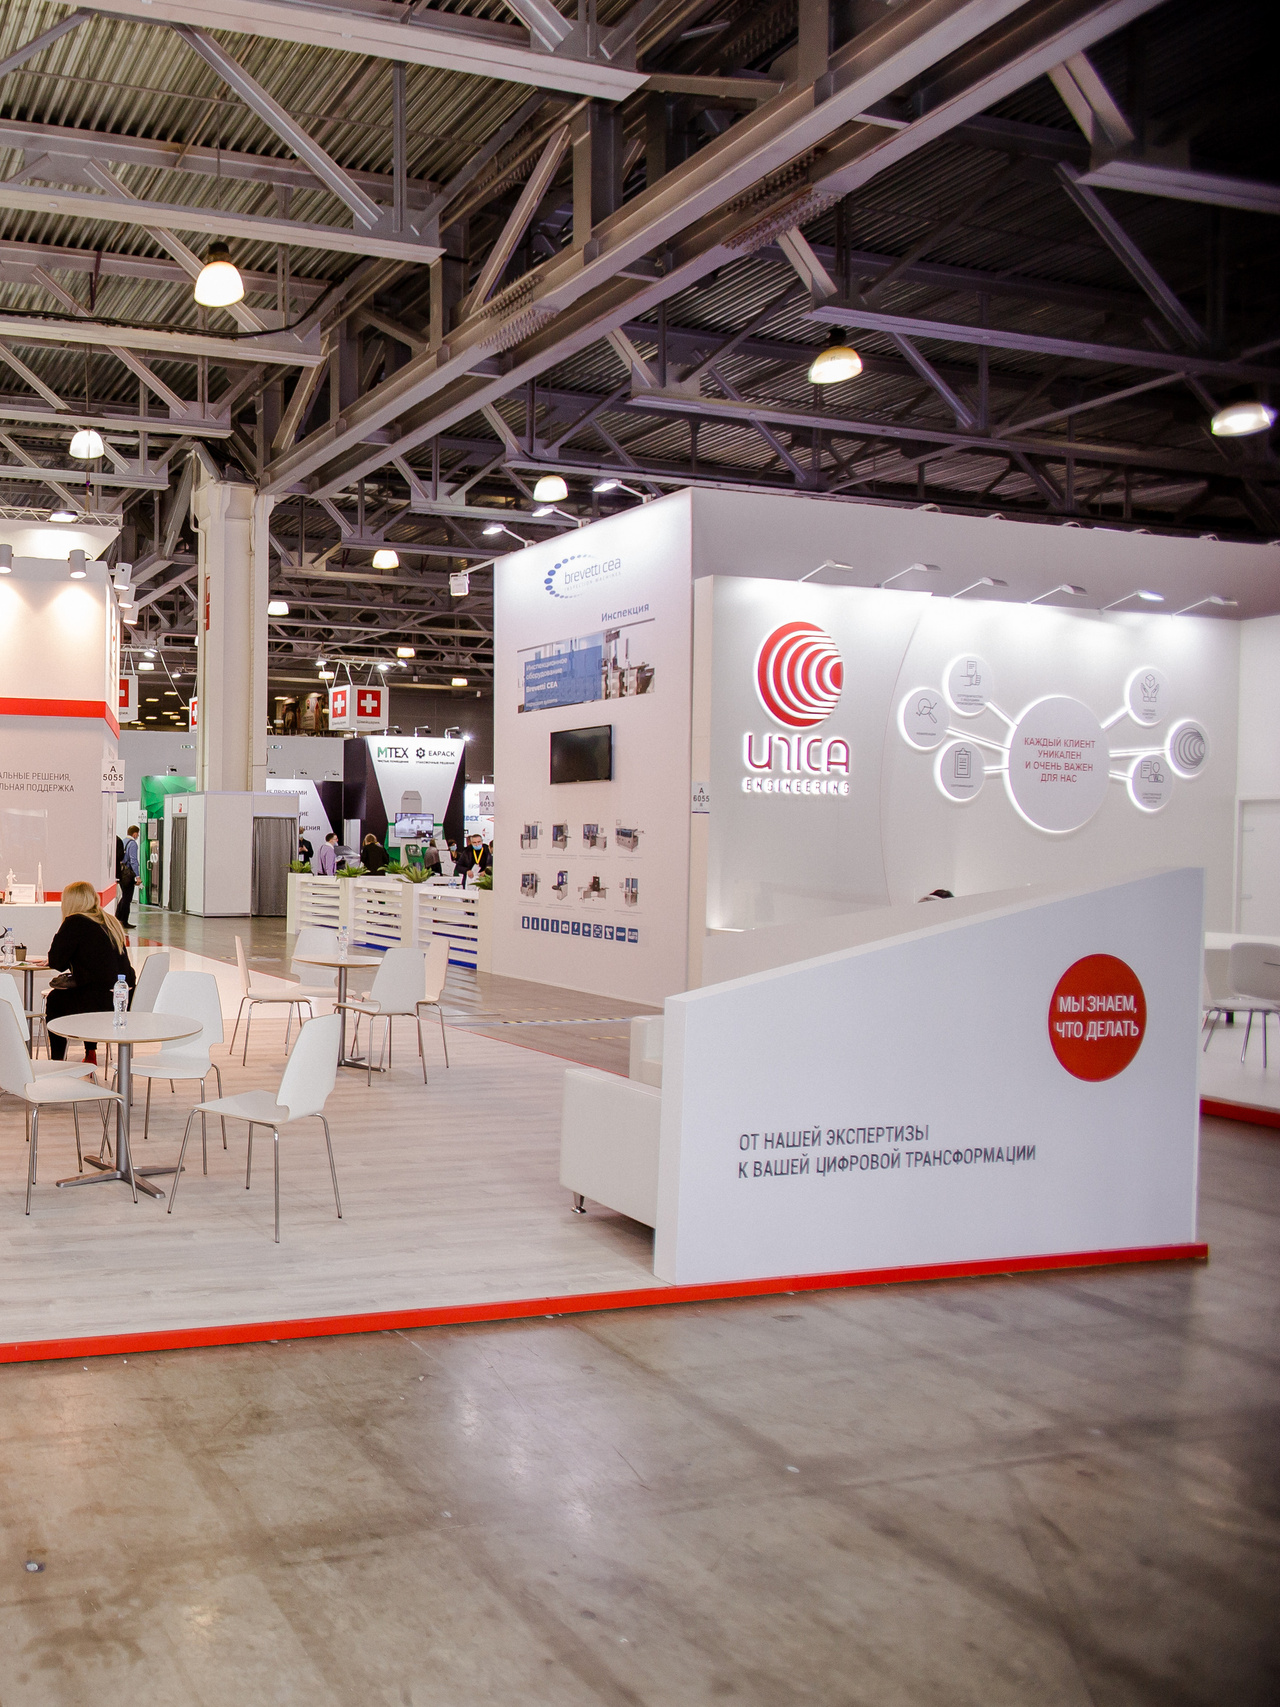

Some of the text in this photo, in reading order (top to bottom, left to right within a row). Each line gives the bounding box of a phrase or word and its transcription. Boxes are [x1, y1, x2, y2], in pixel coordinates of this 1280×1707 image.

[564, 558, 621, 584] brevetti cea
[601, 603, 650, 622] Инспекция
[546, 681, 558, 689] CEA
[1024, 737, 1096, 748] КАЖДЫЙ КЛИЕНТ
[377, 747, 409, 758] MTEX
[748, 734, 849, 773] UNICA
[1037, 750, 1082, 760] УНИКАЛЕН
[1025, 761, 1093, 771] И ОЧЕНЬ ВАЖЕН
[32, 773, 71, 782] РЕШЕНИЯ,
[102, 773, 124, 781] 5055
[1040, 773, 1077, 783] ДЛЯ НАС
[26, 784, 74, 793] ПОДДЕРЖКА
[746, 779, 850, 794] ENGINEERING
[1059, 995, 1137, 1013] МЫ ЗНАЕМ,
[1056, 1020, 1139, 1041] ЧТО ДЕЛАТЬ
[739, 1124, 930, 1151] ОТ НАШЕЙ ЭКСПЕРТИЗЫ
[738, 1144, 1037, 1179] К ВАШЕЙ ЦИФРОВОЙ ТРАНСФОРМАЦИИ
